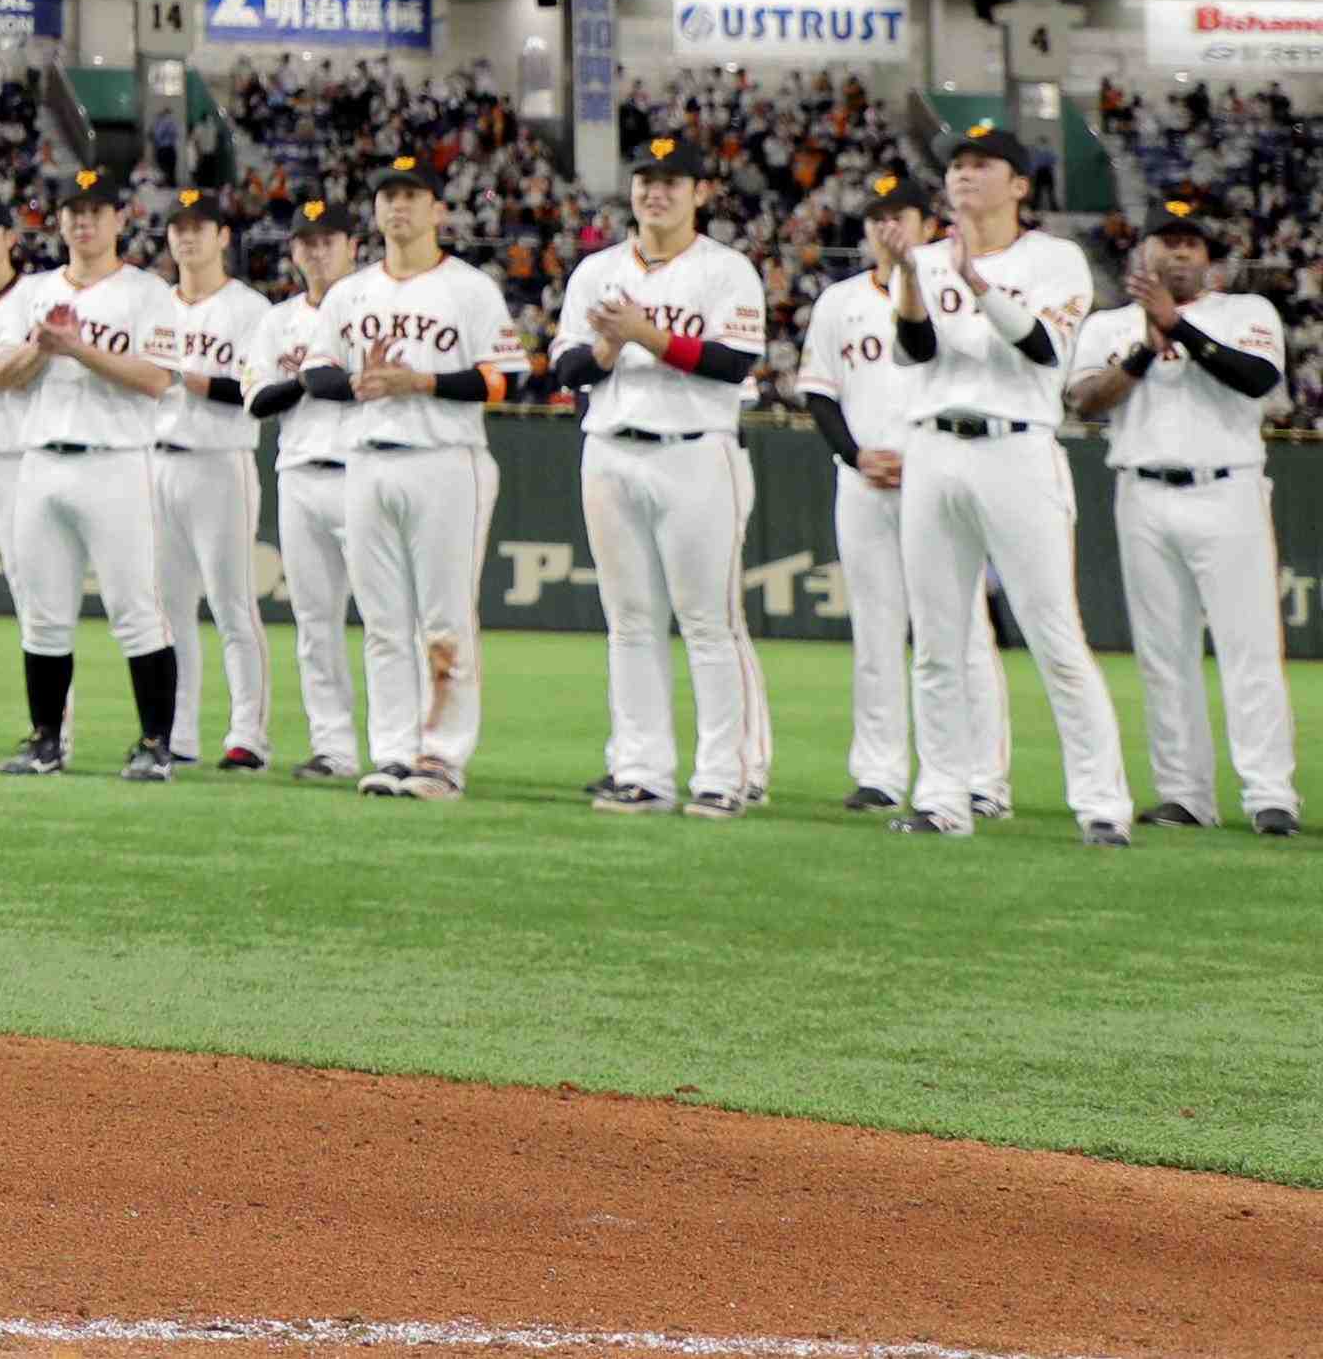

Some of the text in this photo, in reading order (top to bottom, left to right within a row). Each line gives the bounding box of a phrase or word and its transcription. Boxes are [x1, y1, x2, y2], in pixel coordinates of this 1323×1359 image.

[721, 6, 904, 42] USTRUST
[1030, 26, 1051, 54] 4
[340, 314, 459, 352] TOKYO
